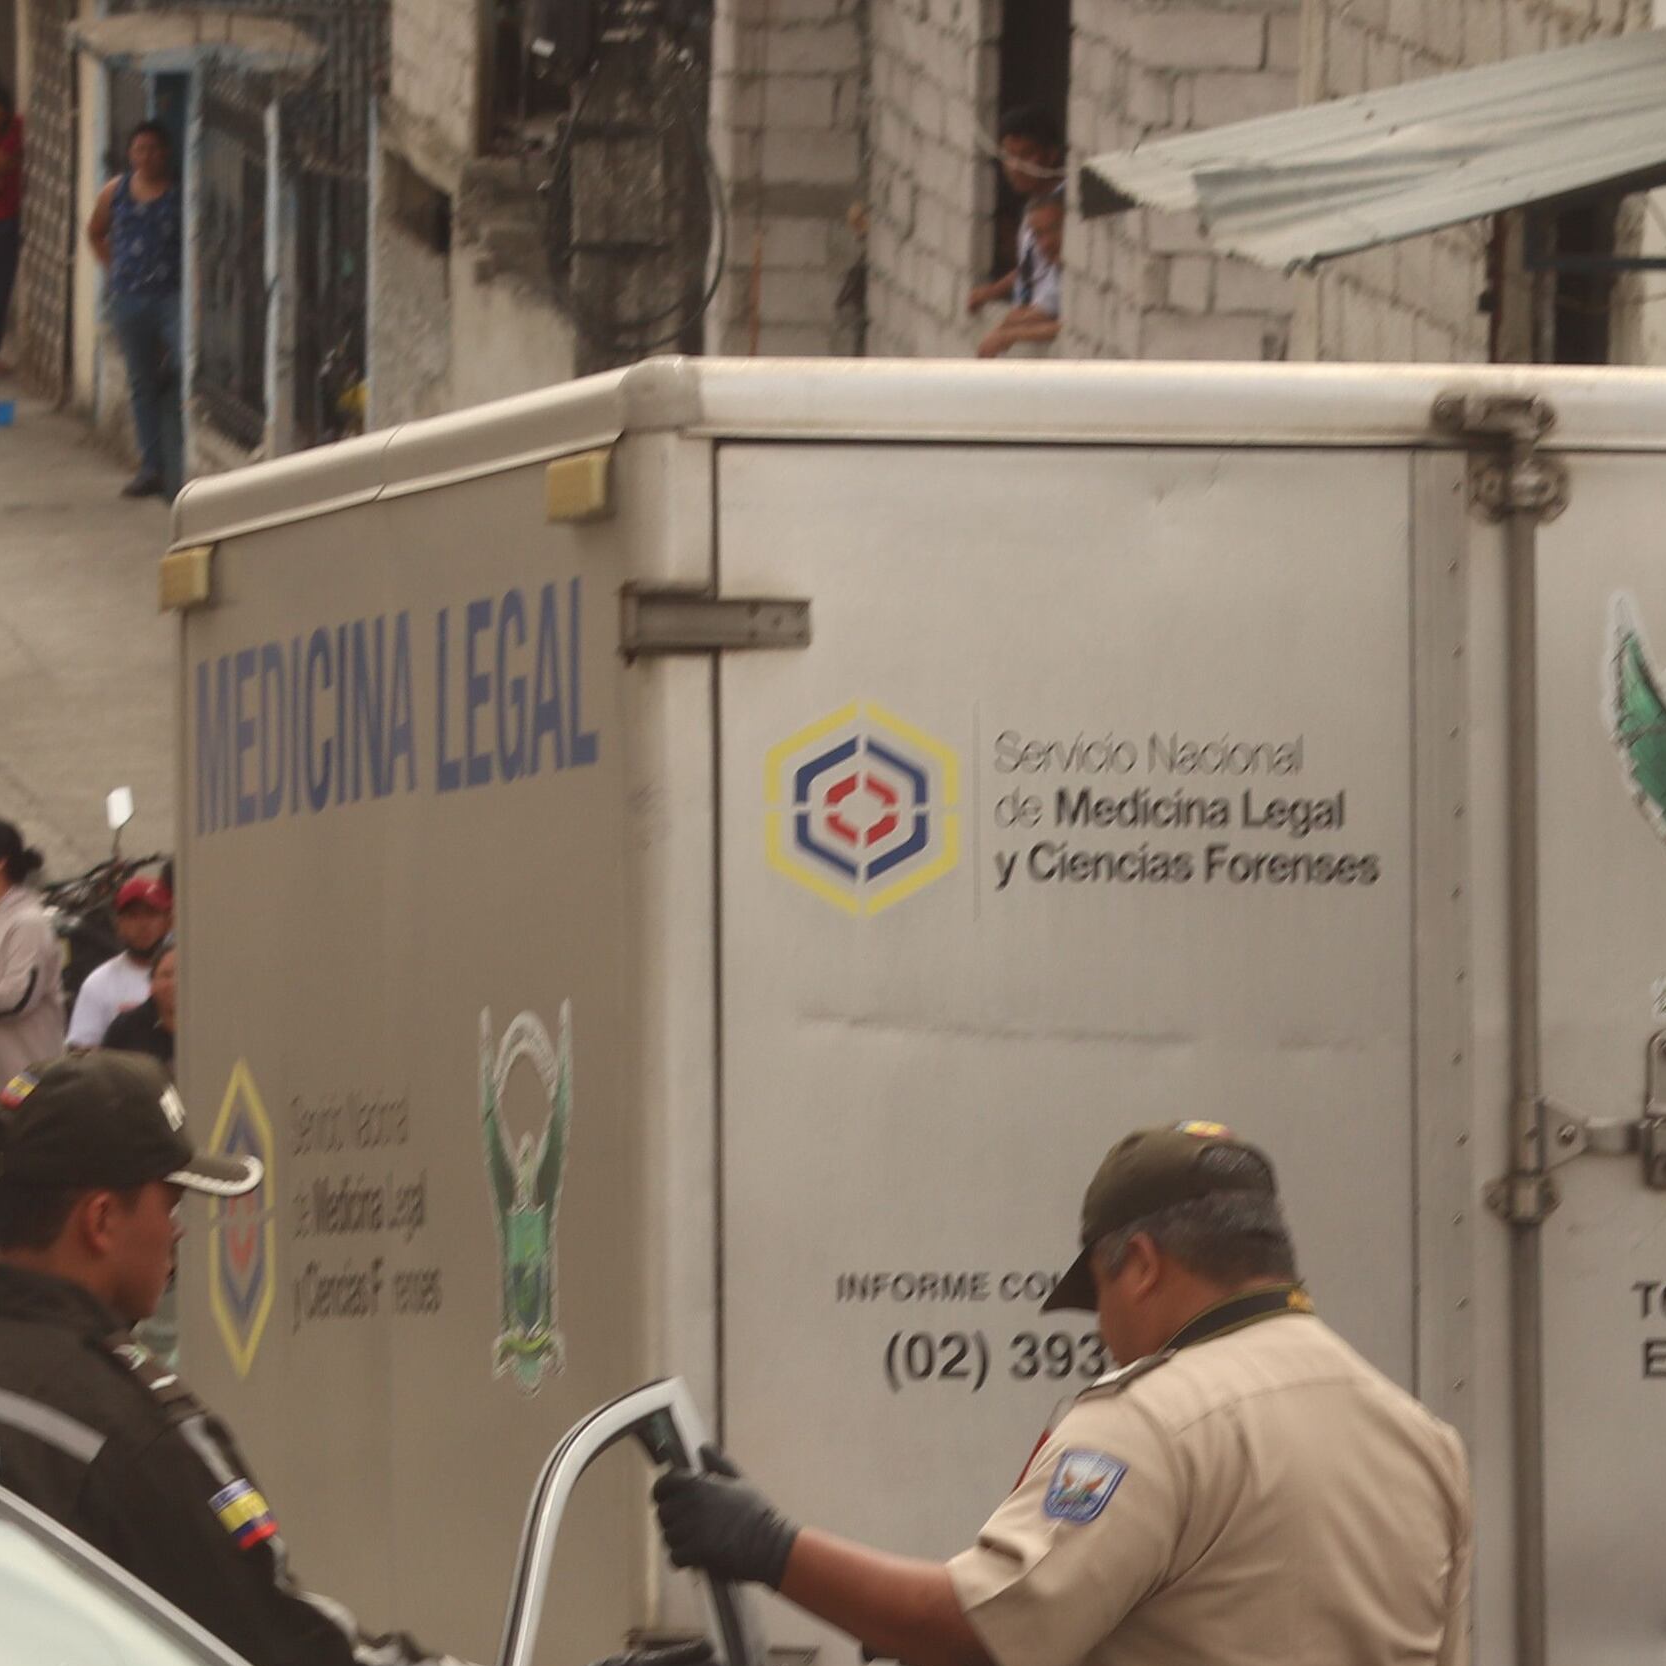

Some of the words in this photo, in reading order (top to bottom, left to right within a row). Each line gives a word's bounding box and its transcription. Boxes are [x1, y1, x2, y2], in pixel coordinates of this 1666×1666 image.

[196, 609, 417, 837] MEDICINA
[436, 575, 599, 794] LEGAL
[994, 730, 1137, 774] Servicio
[1148, 731, 1304, 776] Nacional
[994, 786, 1042, 829] de
[1055, 786, 1229, 829] Medicina
[1242, 788, 1346, 839] Legal
[994, 850, 1018, 892] y
[1026, 839, 1193, 884] Ciencias
[1204, 842, 1381, 887] Forenses
[836, 1271, 990, 1302] INFORME
[885, 1330, 989, 1393] (02)
